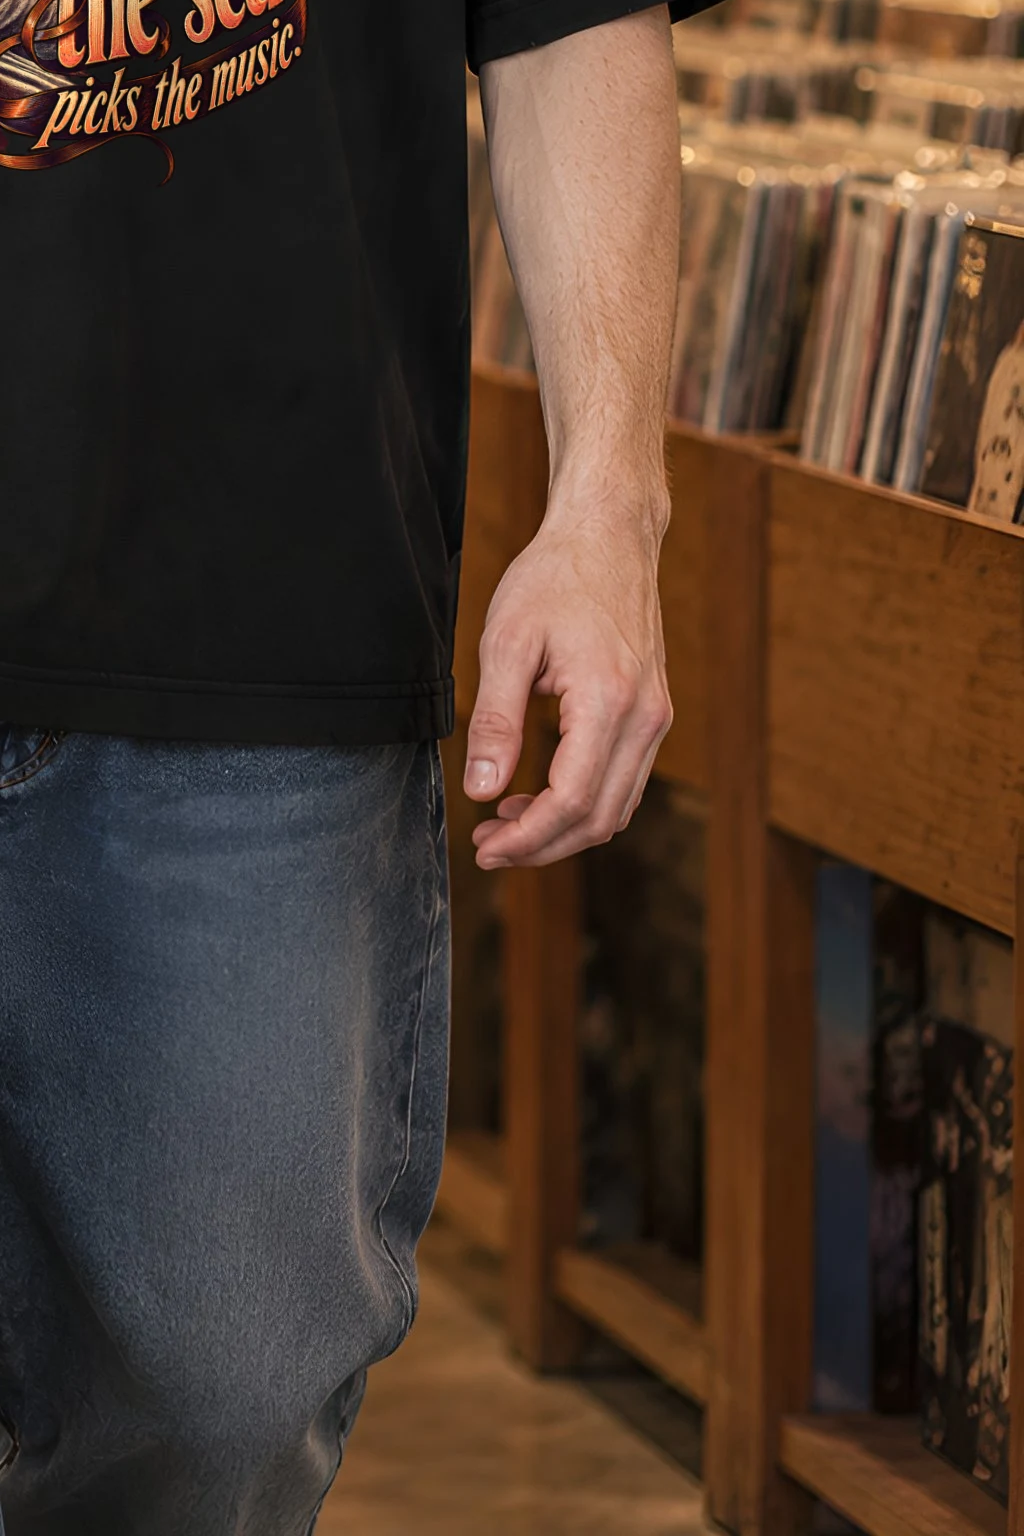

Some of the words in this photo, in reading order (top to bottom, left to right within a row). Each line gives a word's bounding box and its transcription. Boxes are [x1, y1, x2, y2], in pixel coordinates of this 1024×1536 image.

[31, 66, 142, 151] picks
[150, 55, 203, 131] the
[208, 17, 302, 111] music.
